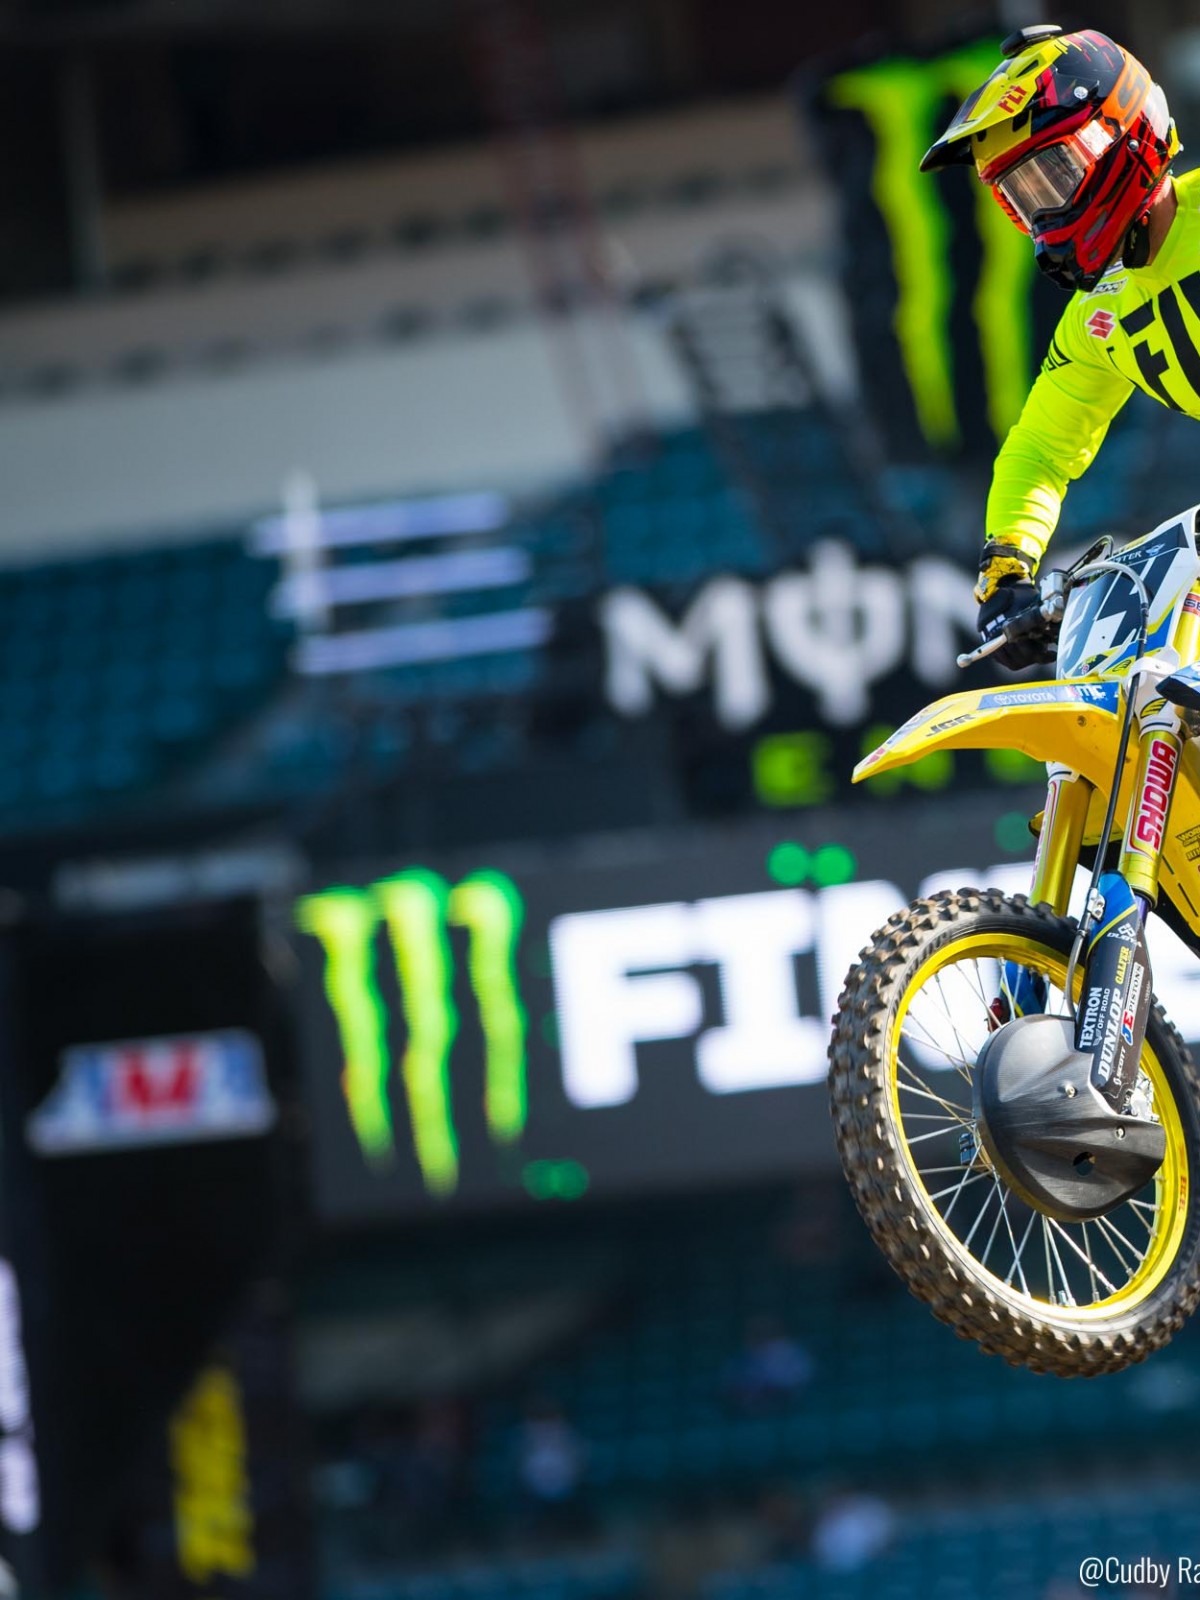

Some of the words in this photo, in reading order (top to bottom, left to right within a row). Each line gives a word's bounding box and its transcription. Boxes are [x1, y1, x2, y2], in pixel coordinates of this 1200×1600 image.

[1010, 691, 1056, 704] TOYOTA
[926, 714, 976, 738] JGR
[1135, 739, 1177, 852] SHOWA
[1101, 988, 1111, 1012] ROAD
[1128, 964, 1144, 1015] PISTONS
[1079, 987, 1103, 1049] TEXTRON
[1097, 1013, 1106, 1029] OFF
[1098, 987, 1124, 1082] DUNLOP
[1121, 1010, 1135, 1047] JE
[1115, 1047, 1127, 1078] SCOTT
